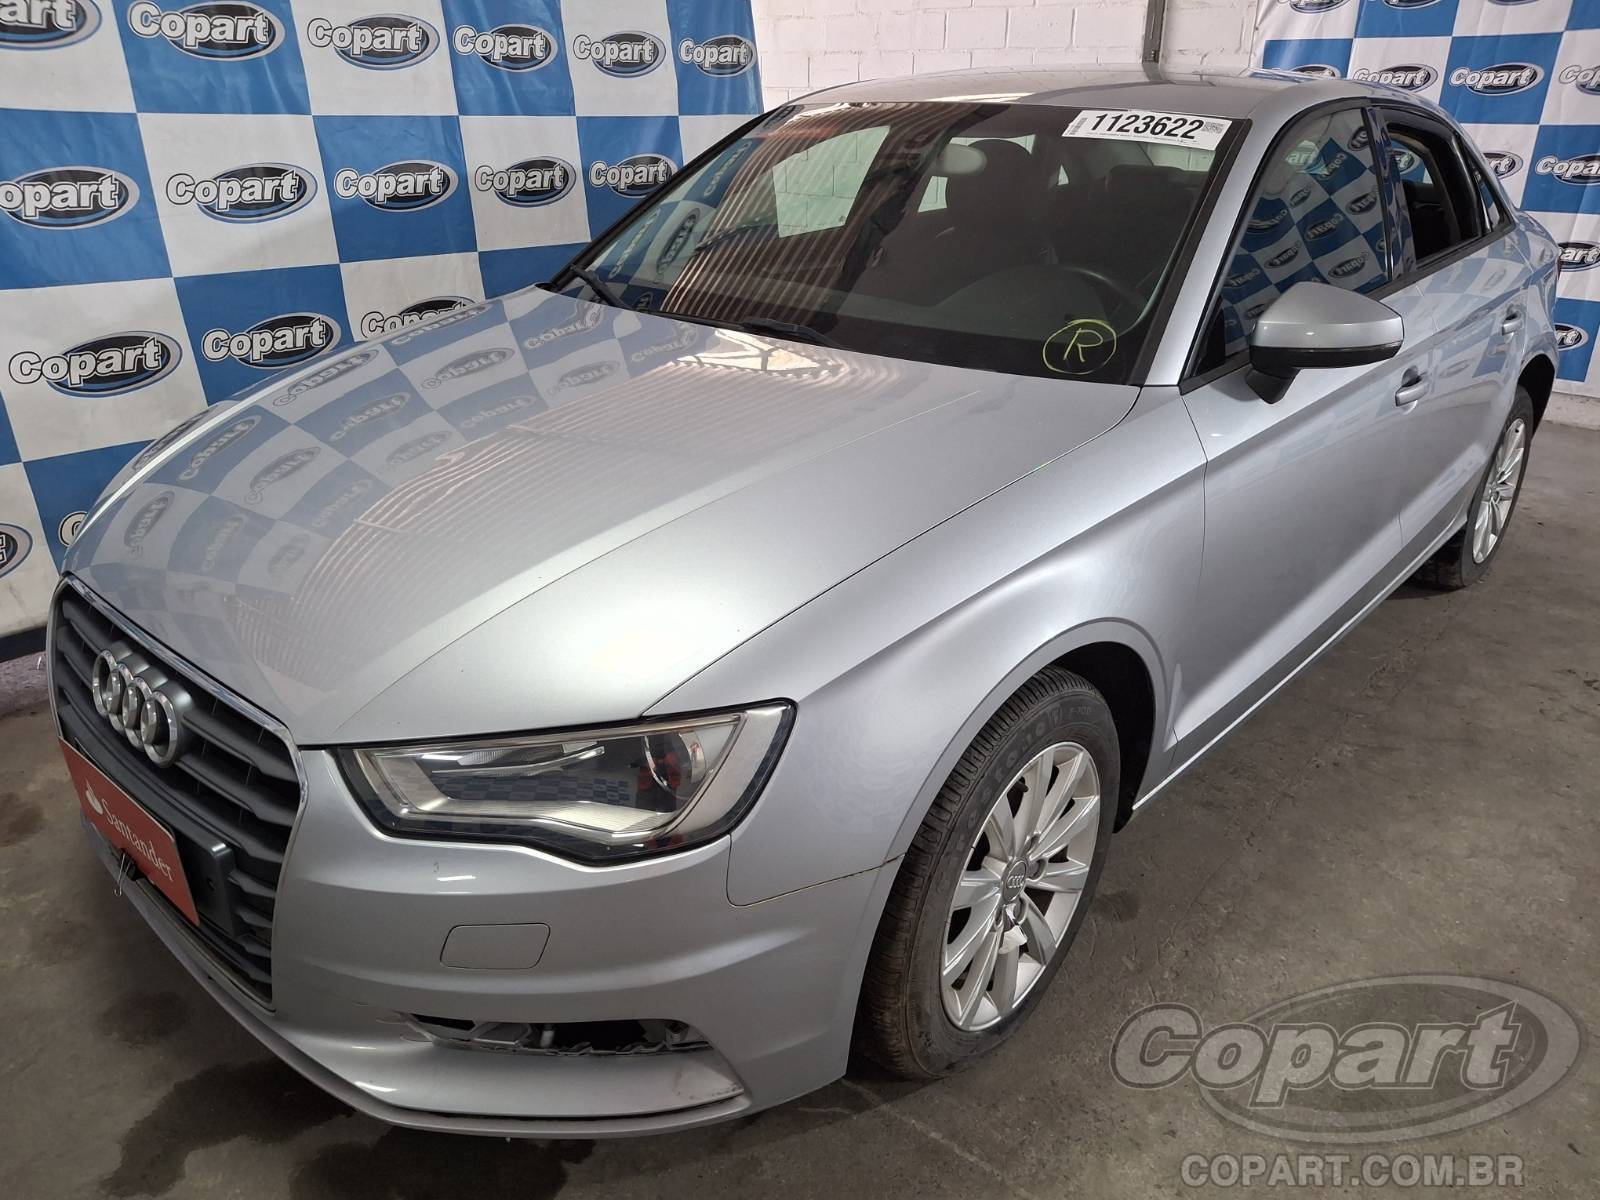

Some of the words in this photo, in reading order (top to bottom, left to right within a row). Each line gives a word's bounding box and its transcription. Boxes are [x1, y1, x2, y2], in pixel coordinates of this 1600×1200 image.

[0, 0, 77, 31] art
[128, 1, 270, 47] Copart
[306, 17, 422, 57] Copart
[453, 24, 547, 62] Copart
[573, 34, 655, 67] Copart
[679, 38, 750, 68] Copart
[1449, 66, 1536, 90] Copart
[1559, 65, 1600, 88] Cop
[1091, 113, 1205, 140] 1123622
[474, 164, 566, 198] Copart
[589, 159, 669, 191] Copart
[1535, 155, 1600, 179] Copa
[0, 173, 119, 219] opart
[166, 169, 301, 211] Copart
[333, 166, 443, 204] Copart
[1559, 245, 1600, 263] art
[202, 316, 327, 361] Copart
[1063, 328, 1103, 363] R
[8, 337, 165, 386] Copart
[101, 798, 173, 882] Santander
